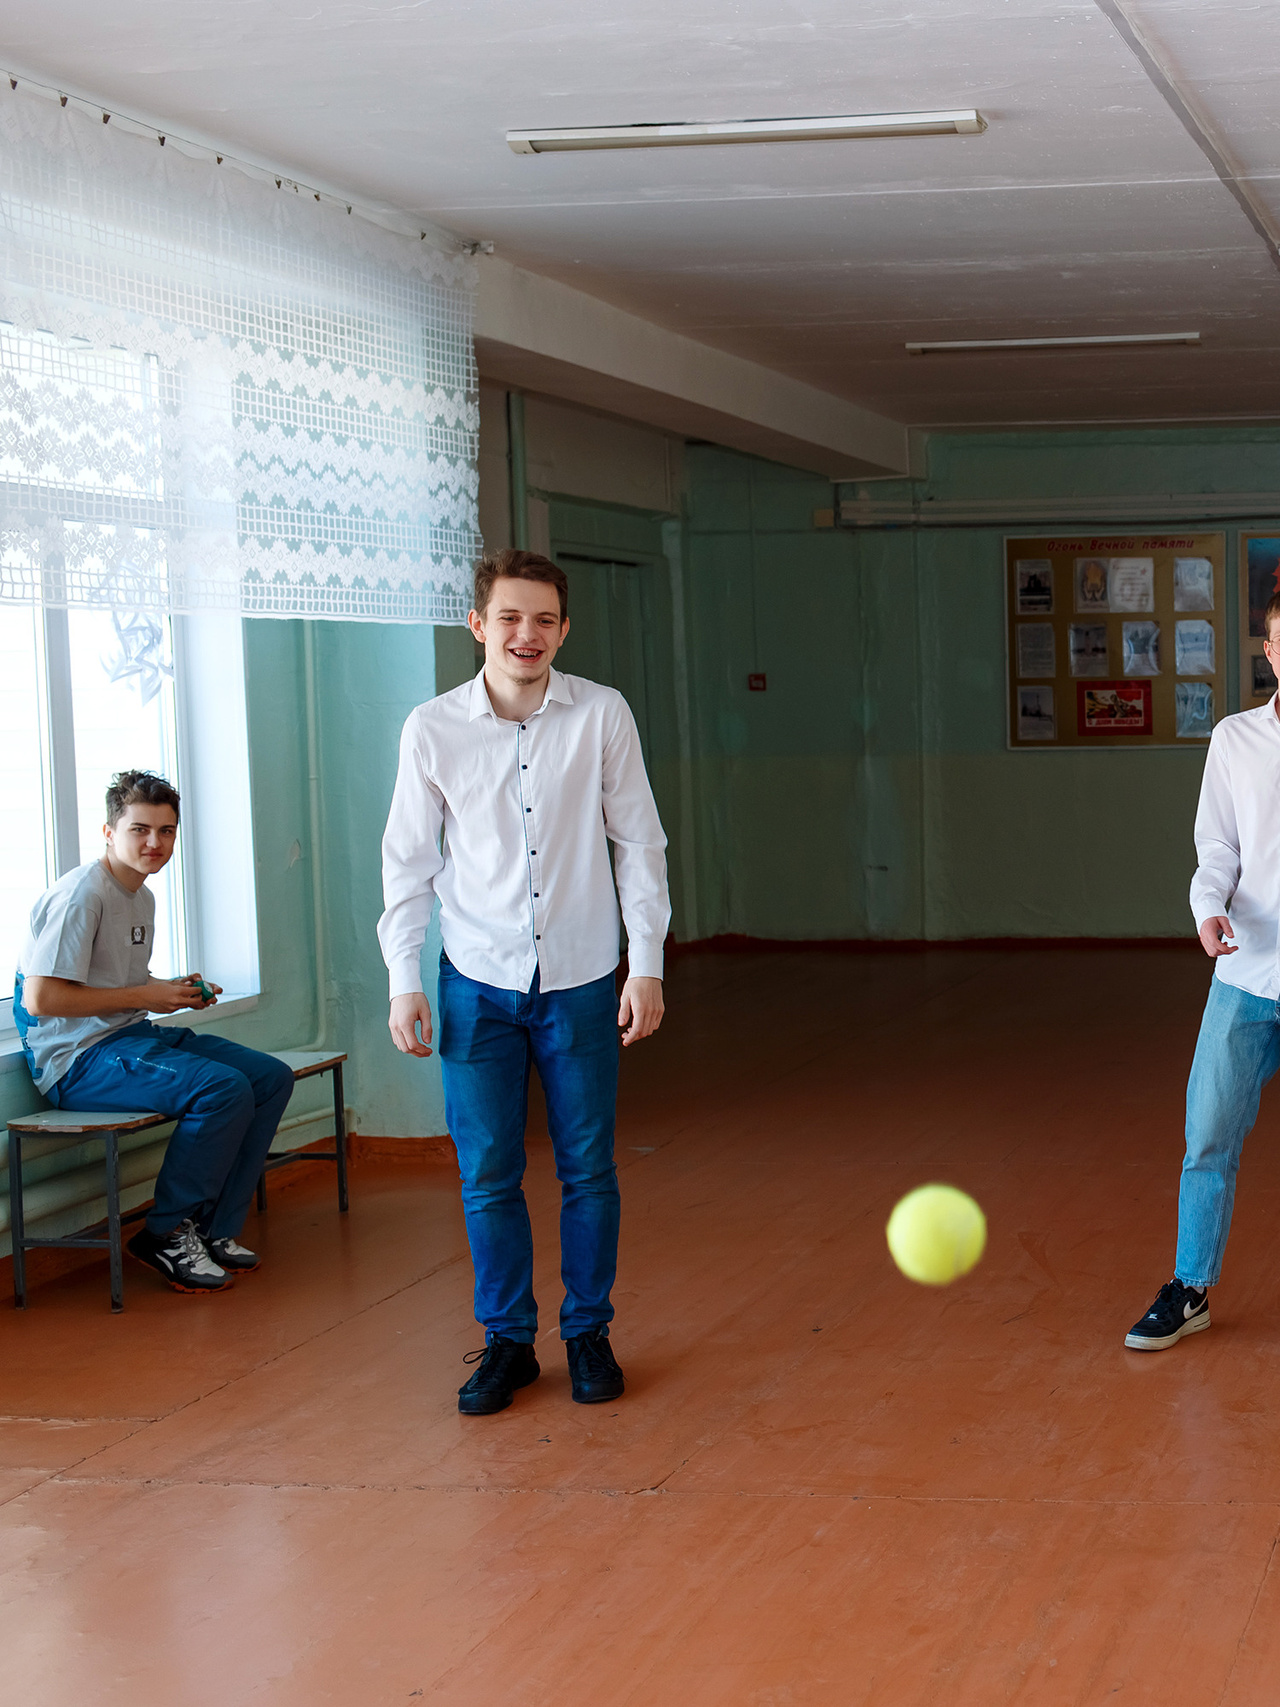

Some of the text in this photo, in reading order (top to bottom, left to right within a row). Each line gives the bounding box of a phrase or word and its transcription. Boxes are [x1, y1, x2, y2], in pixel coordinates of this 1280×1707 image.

[1047, 538, 1195, 552] Огонь Вечной памяти
